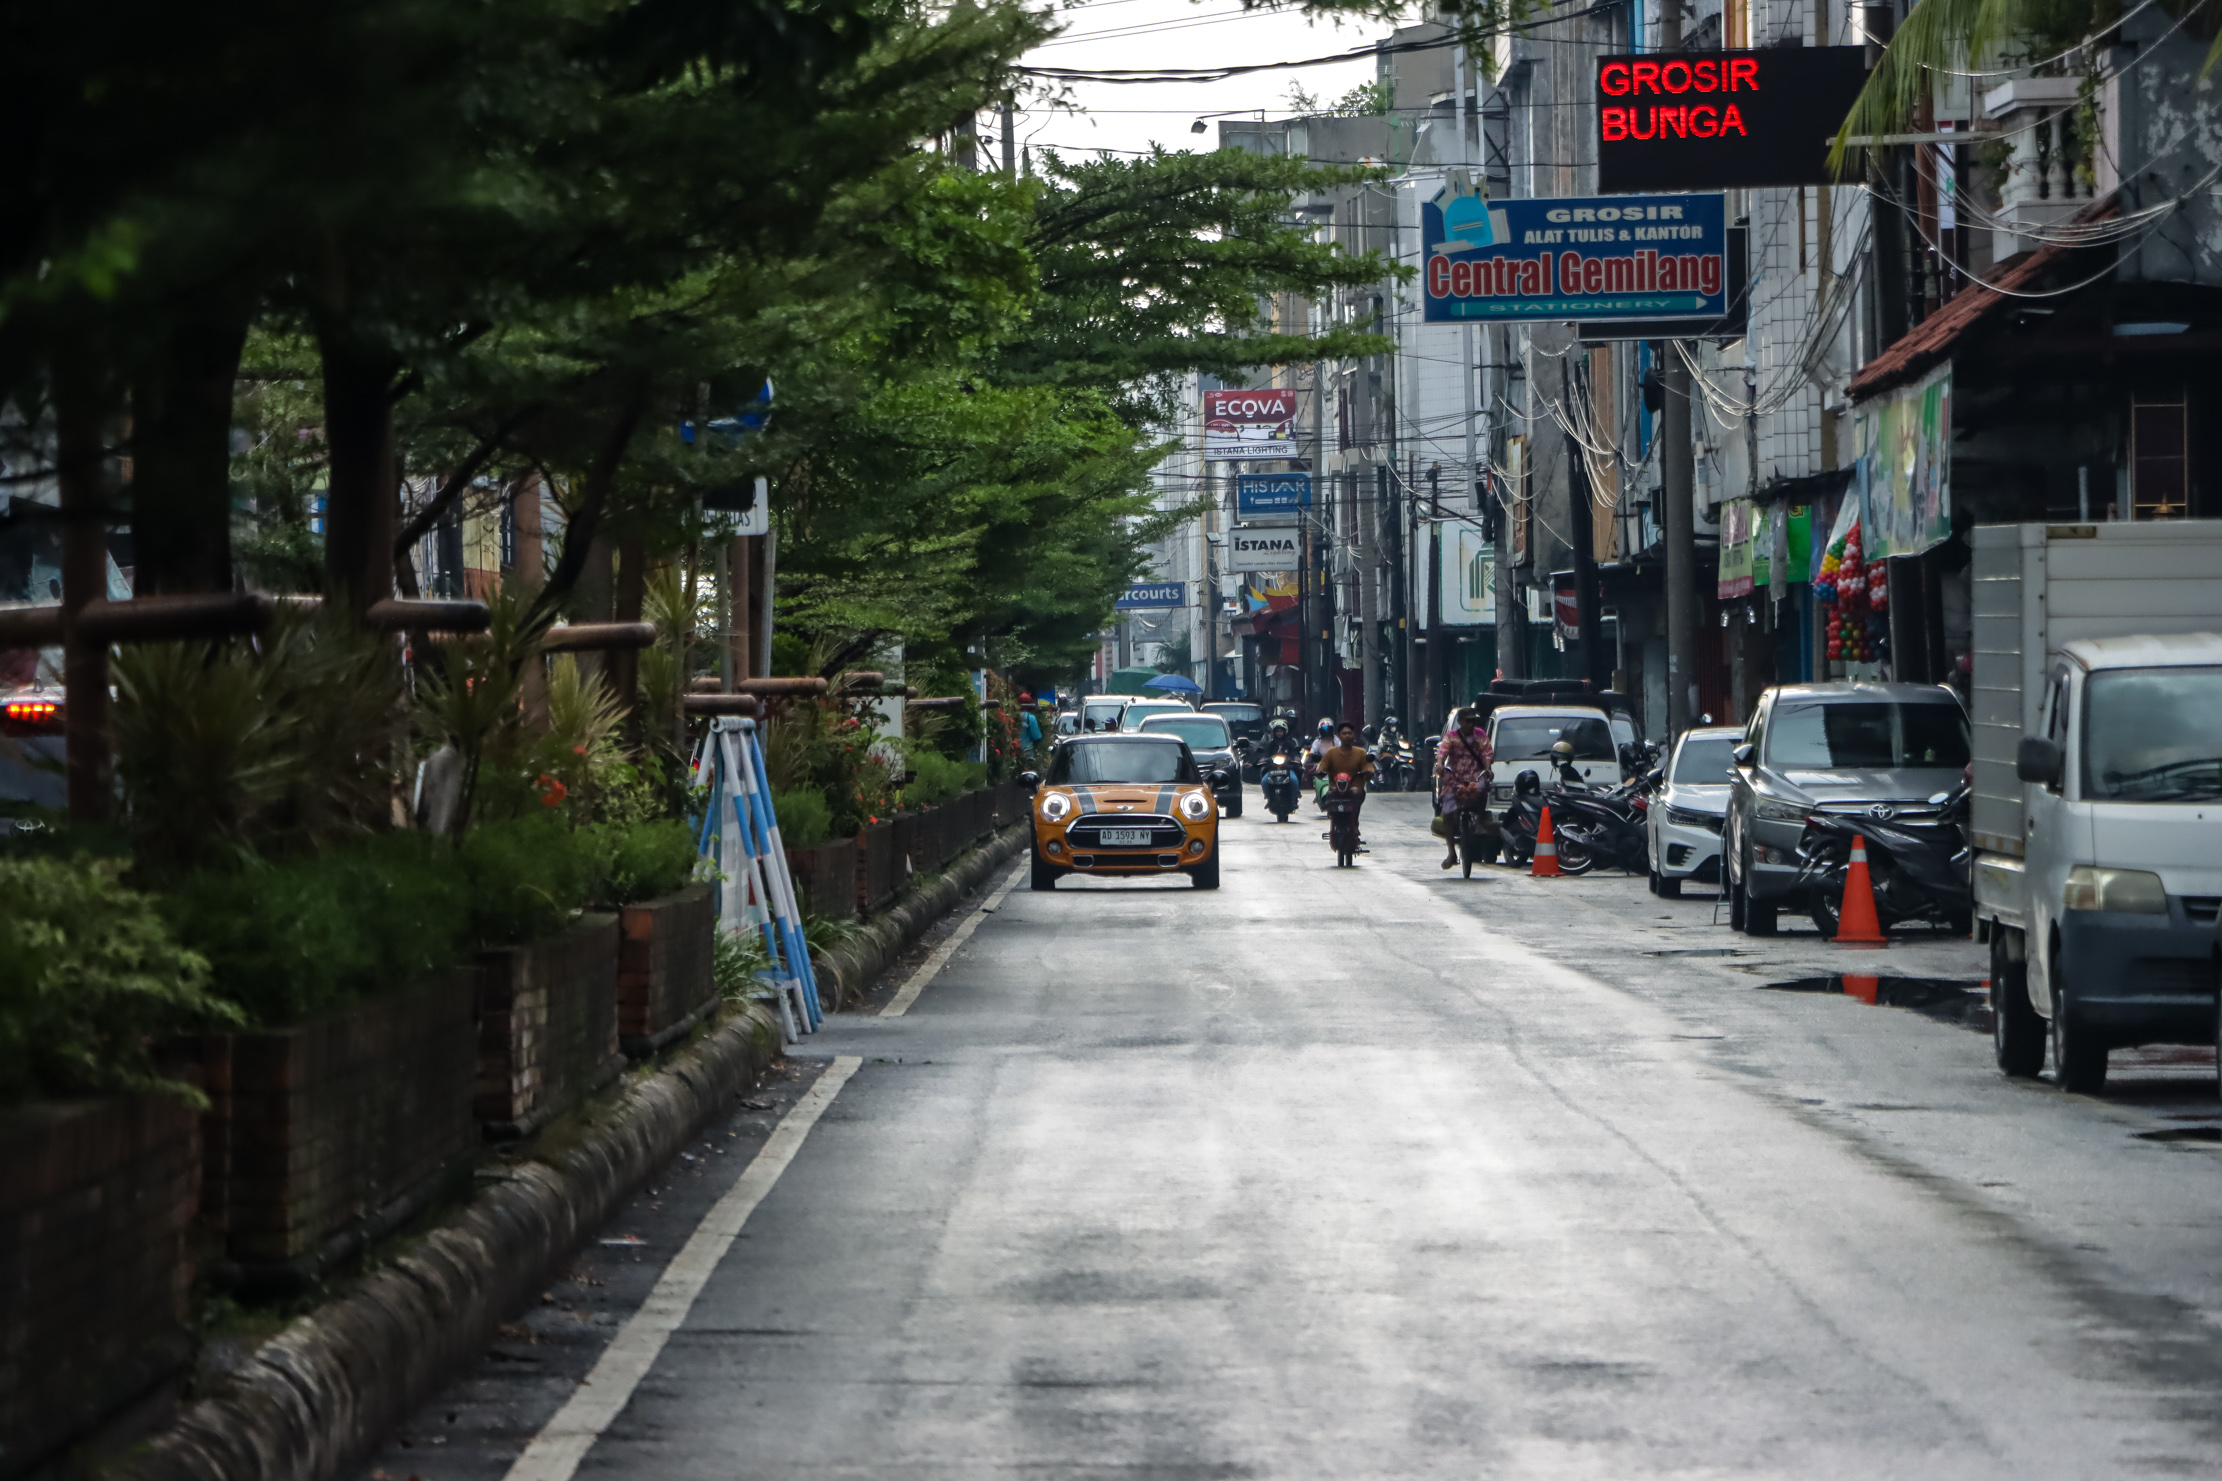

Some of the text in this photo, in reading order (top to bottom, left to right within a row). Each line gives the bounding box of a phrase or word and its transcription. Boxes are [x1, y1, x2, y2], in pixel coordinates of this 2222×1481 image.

[1600, 57, 1760, 96] GROSIR
[1602, 102, 1748, 141] BUNGA
[1546, 206, 1684, 223] GROSIR
[1523, 226, 1703, 244] ALAT TULIS & KANTOR
[1428, 250, 1721, 298] Central Gemilang
[1489, 300, 1670, 312] STATIONERY
[1215, 399, 1286, 417] ECOVA
[1214, 446, 1288, 455] ISTANA LIGHTING
[1102, 831, 1150, 840] AD 1593 NY
